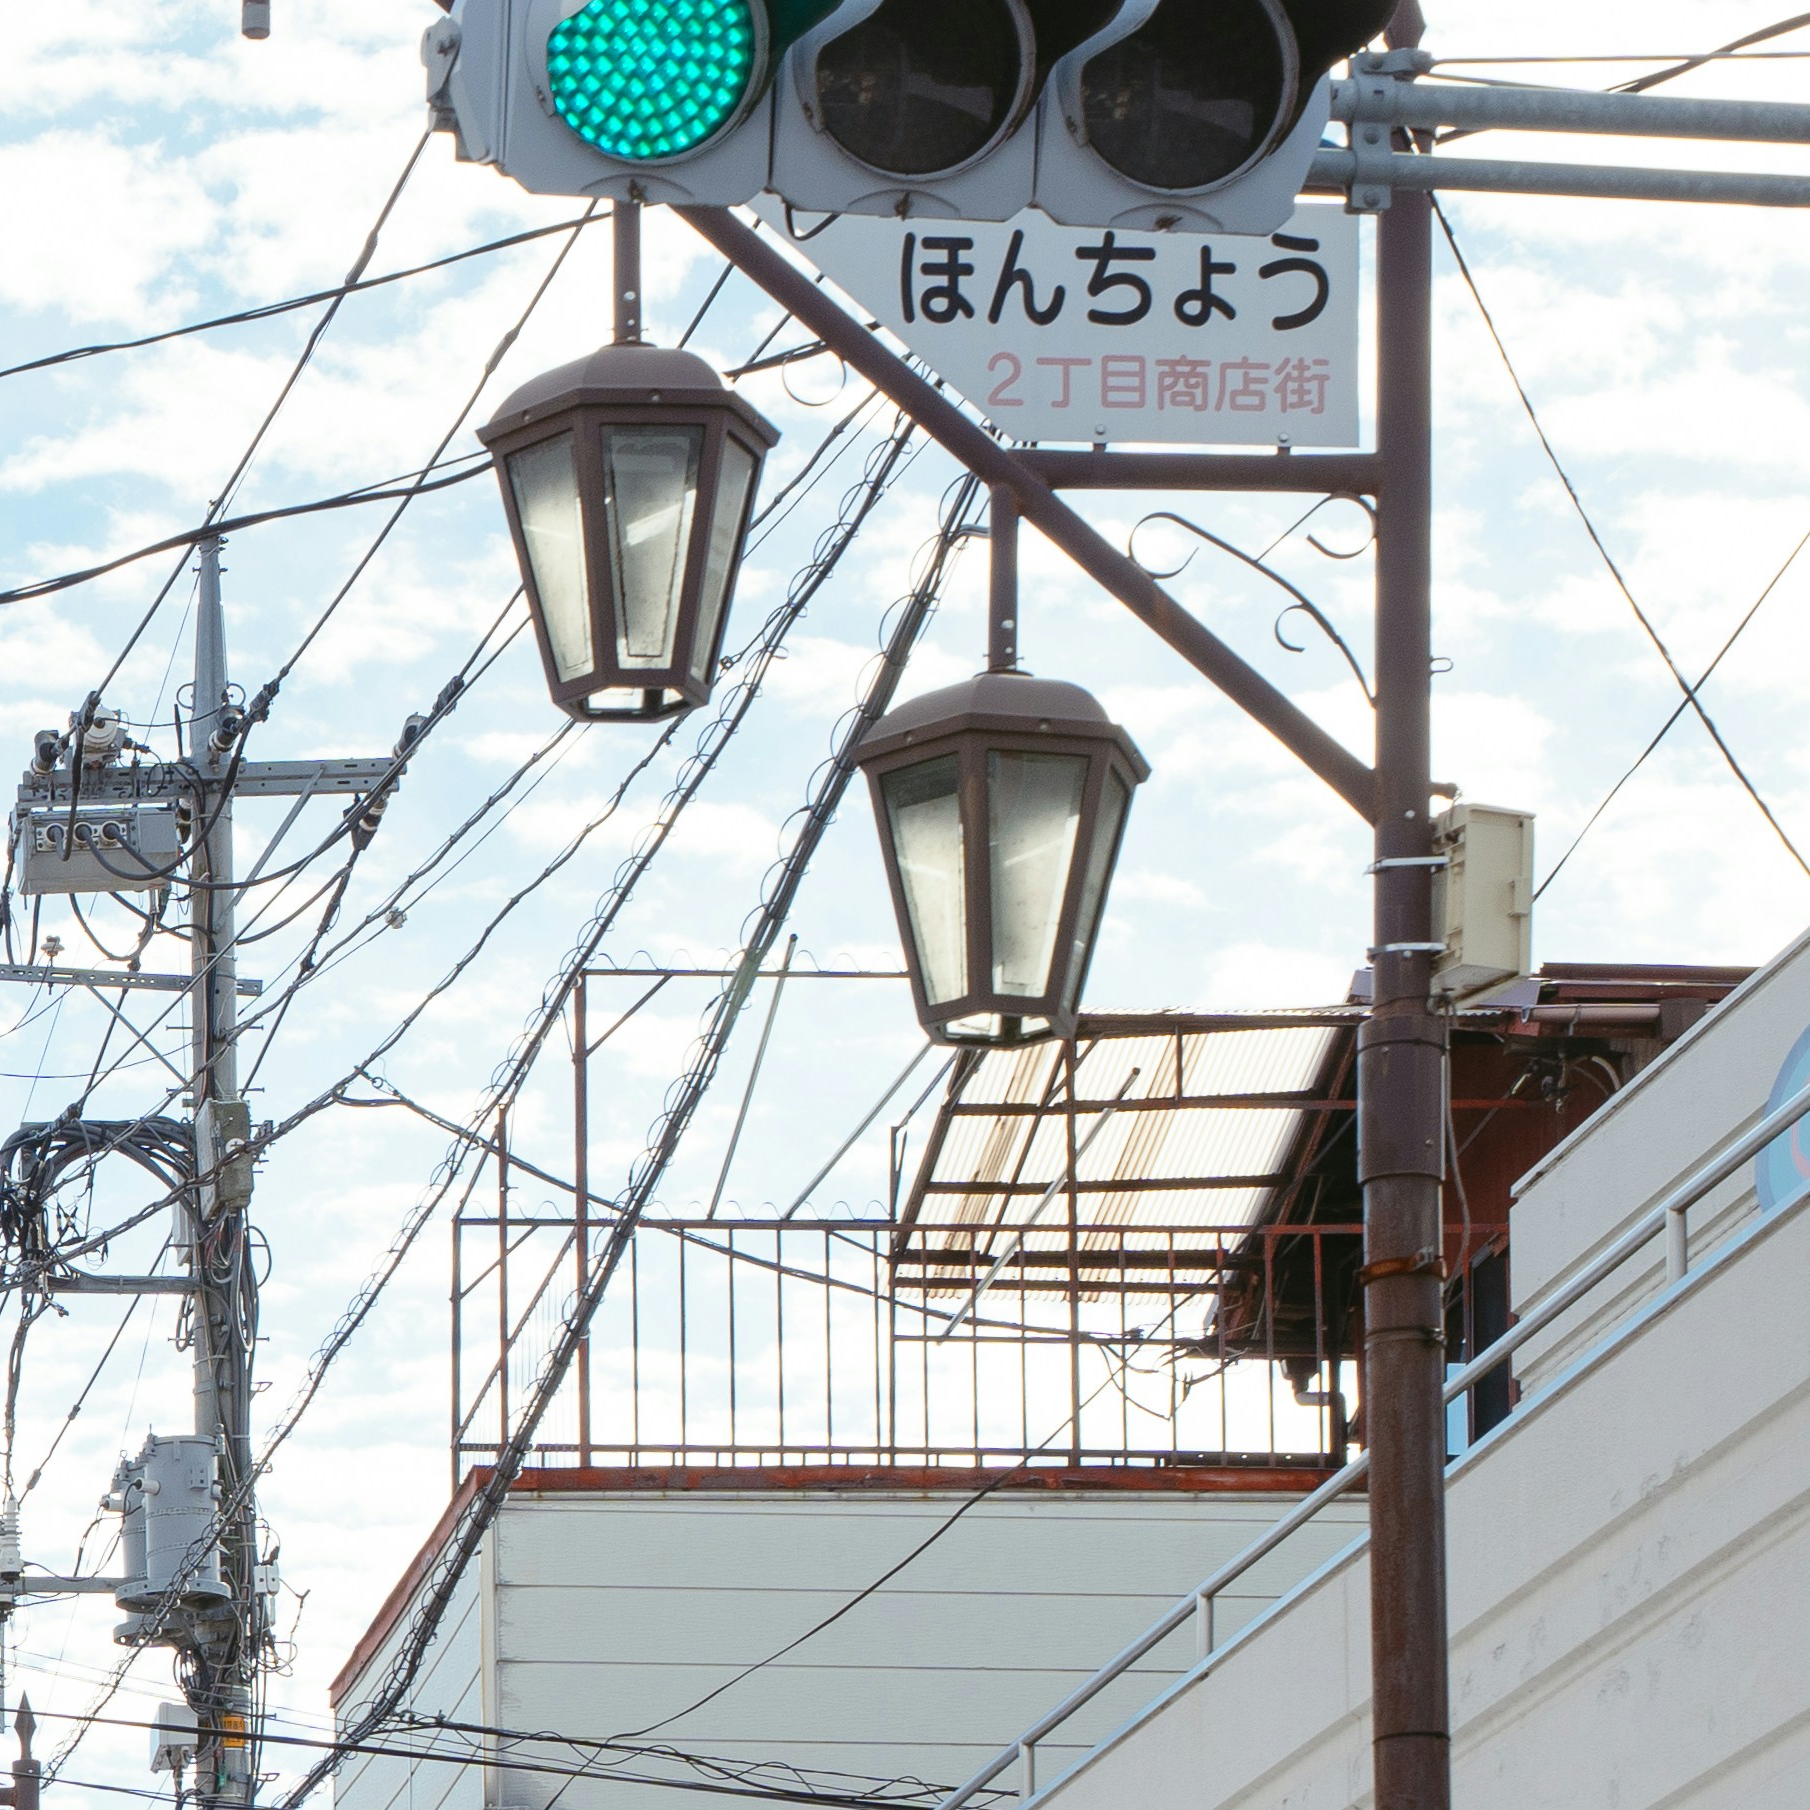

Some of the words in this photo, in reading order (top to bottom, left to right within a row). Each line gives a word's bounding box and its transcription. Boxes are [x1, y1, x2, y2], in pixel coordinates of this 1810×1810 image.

[899, 224, 1331, 332] ほんちょう
[987, 352, 1331, 416] 2丁目商店街
